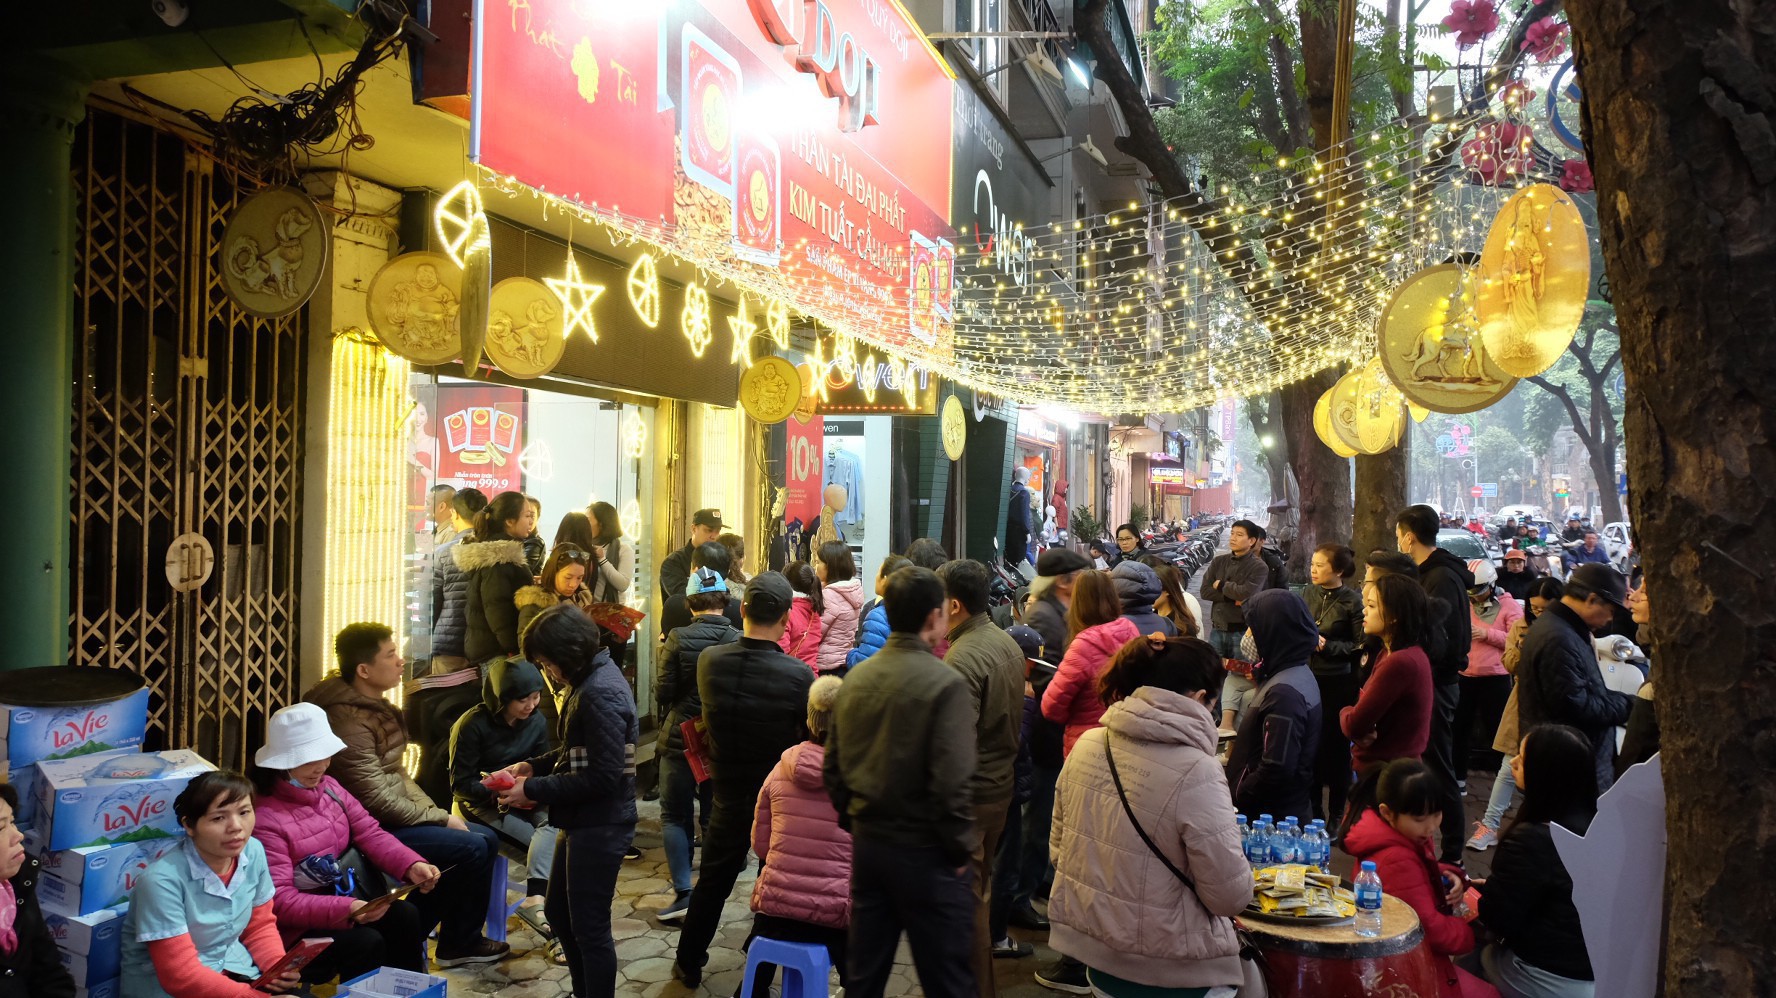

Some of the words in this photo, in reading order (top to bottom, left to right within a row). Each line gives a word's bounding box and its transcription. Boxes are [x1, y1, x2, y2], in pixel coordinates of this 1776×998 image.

[811, 0, 881, 132] DOJI
[980, 117, 1004, 171] trang
[832, 152, 853, 197] TÀI
[789, 180, 817, 230] KIM
[818, 200, 855, 253] TUẤT
[790, 434, 820, 481] 10%
[478, 479, 509, 489] 999.9
